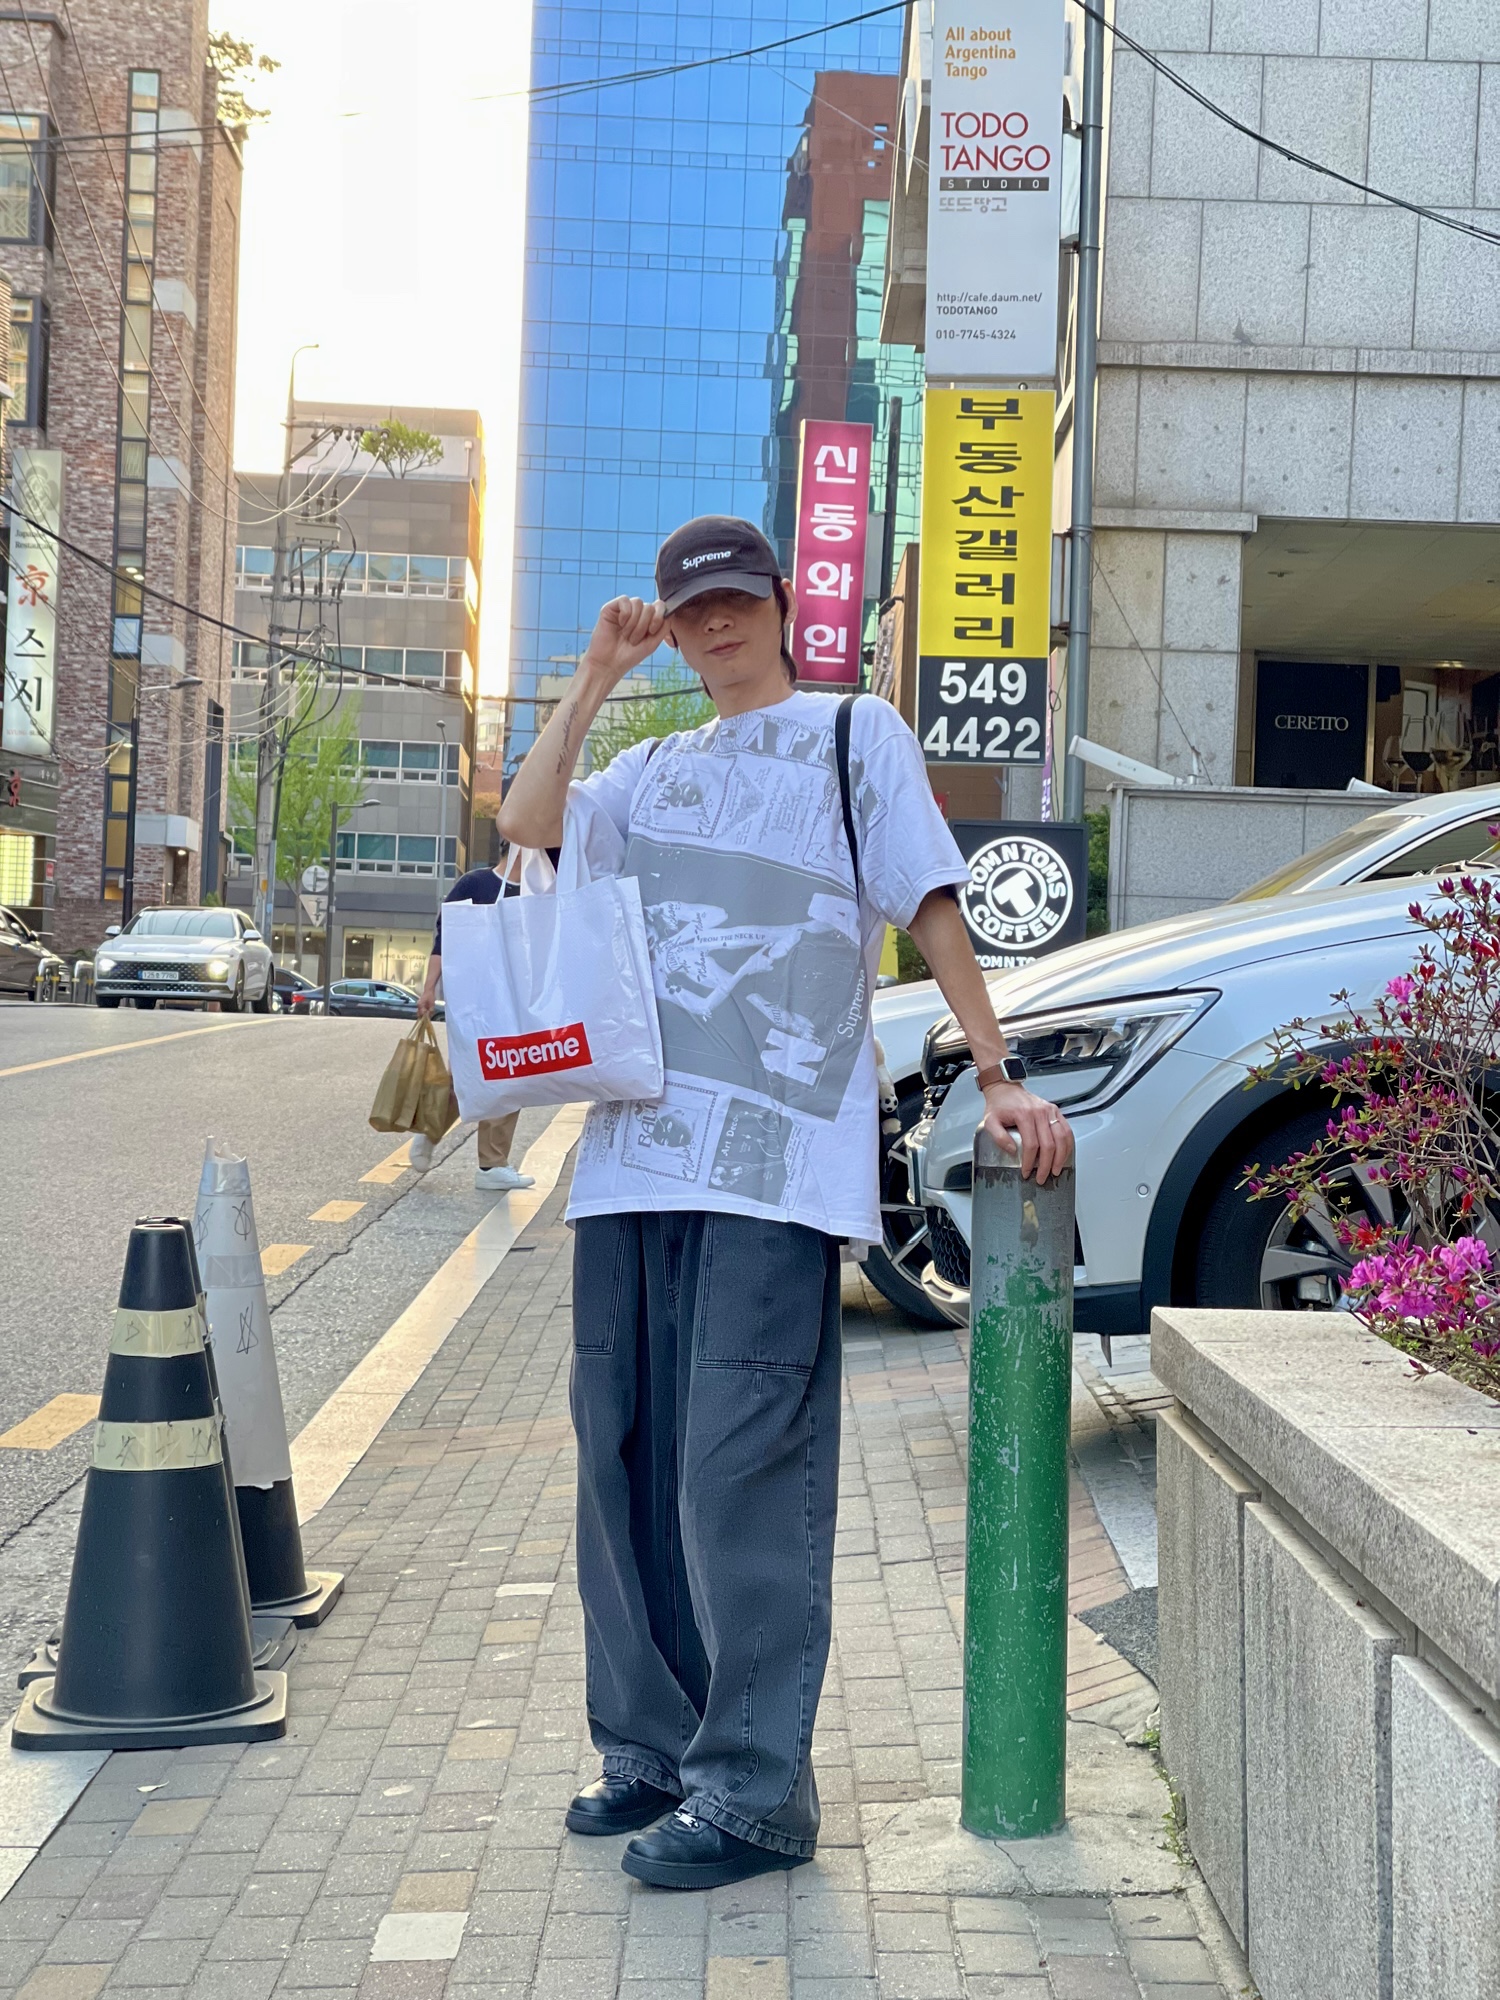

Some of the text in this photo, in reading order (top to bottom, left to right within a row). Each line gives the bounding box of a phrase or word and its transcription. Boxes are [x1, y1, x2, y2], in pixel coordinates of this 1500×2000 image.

[945, 27, 1011, 41] All about
[944, 45, 1016, 63] Argentina
[944, 63, 988, 80] Tango
[940, 111, 1029, 139] TODO
[940, 144, 1051, 172] TANGO
[947, 178, 1040, 189] STUDIO
[939, 197, 1008, 213] 또도땅고
[936, 291, 1043, 304] http://cafe.daum.net/
[936, 305, 998, 316] TODOTANGO
[935, 329, 1017, 340] 010-7745-4324
[951, 397, 1025, 649] 부동산갤러리
[682, 550, 732, 570] Supreme
[803, 444, 859, 665] 신동와인
[939, 661, 1028, 706] 549
[1274, 714, 1350, 732] CERETTO
[923, 715, 1041, 759] 4422
[972, 904, 1060, 943] COFFEE
[734, 932, 753, 940] NECK
[485, 1037, 580, 1076] Supreme
[637, 1103, 660, 1148] BALI
